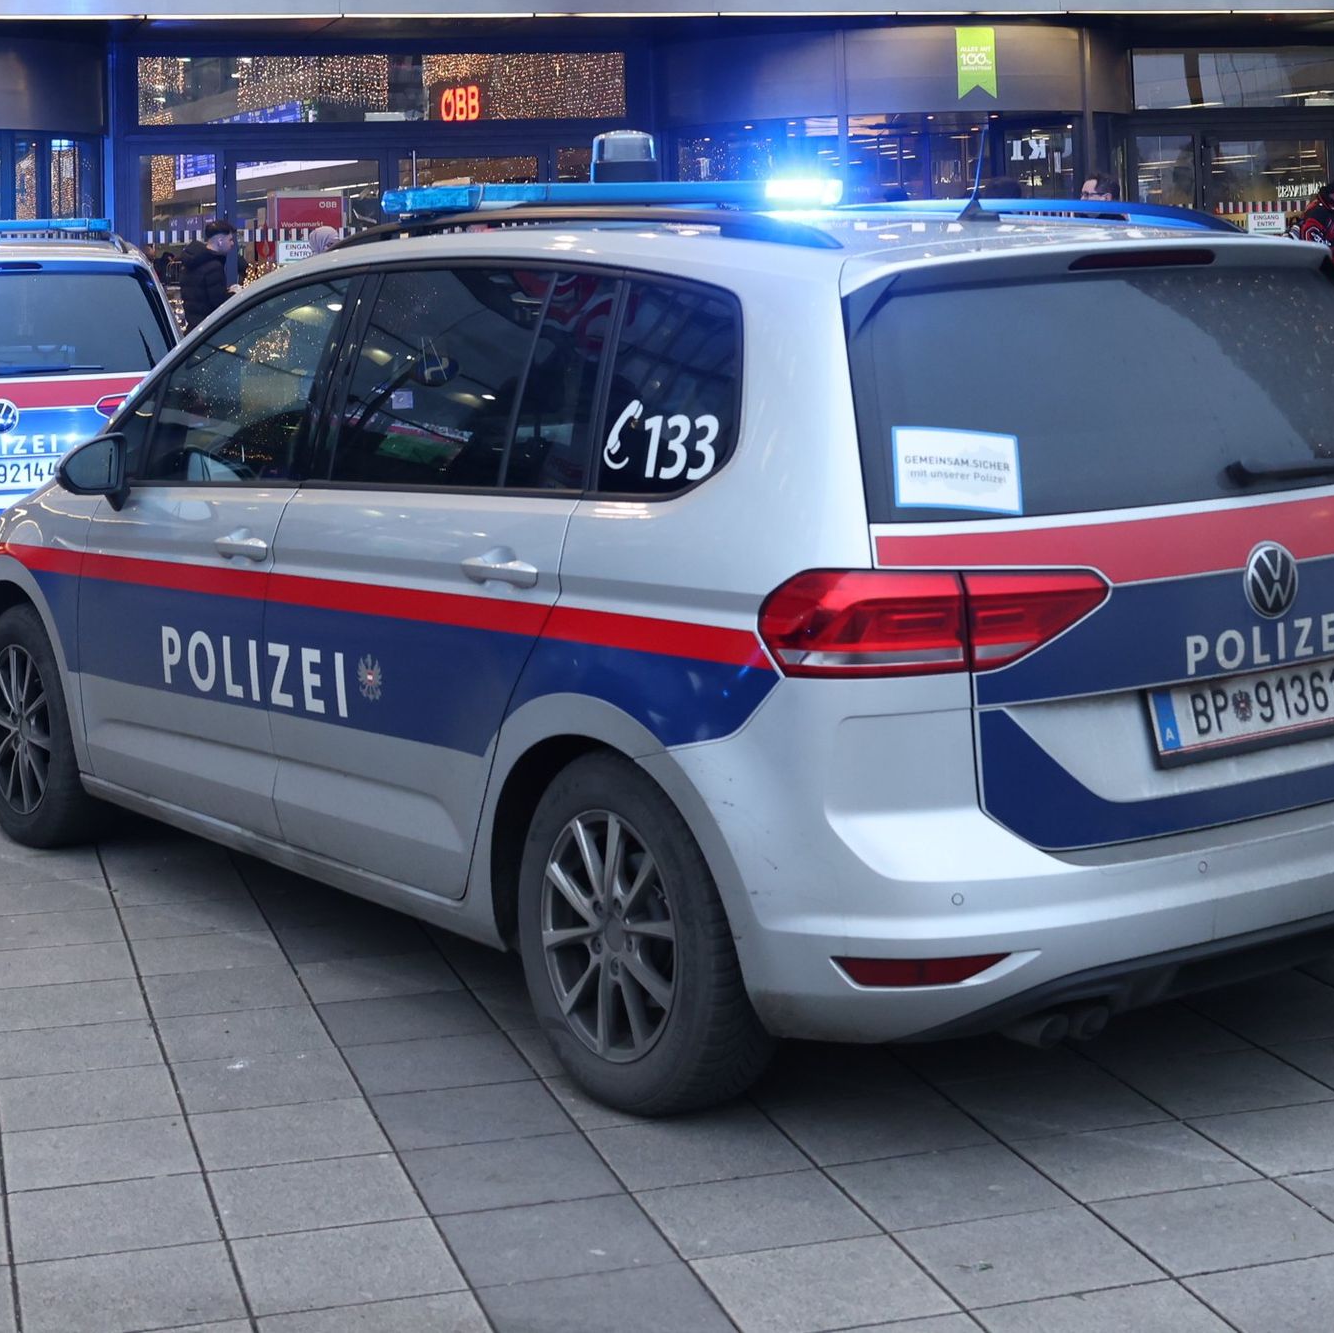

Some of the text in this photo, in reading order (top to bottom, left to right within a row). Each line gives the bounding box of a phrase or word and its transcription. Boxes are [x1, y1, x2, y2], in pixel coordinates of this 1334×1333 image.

[644, 414, 719, 480] 133
[910, 470, 1006, 484] mit unserer Polizei
[161, 625, 349, 718] POLIZEI
[1165, 727, 1175, 742] A
[1190, 688, 1229, 736] BP
